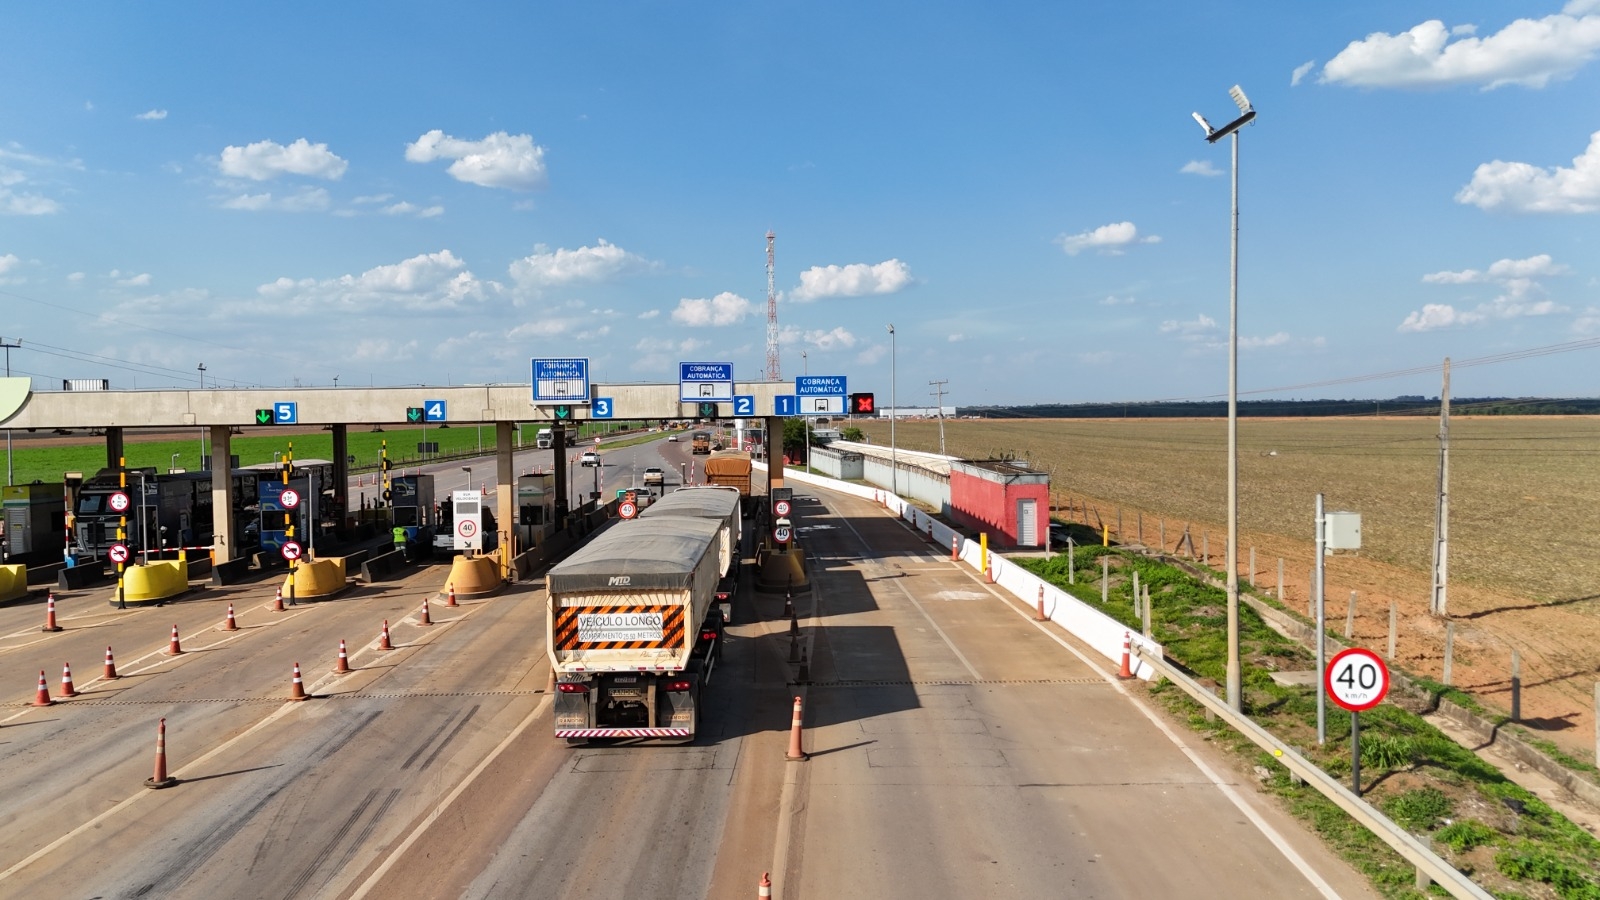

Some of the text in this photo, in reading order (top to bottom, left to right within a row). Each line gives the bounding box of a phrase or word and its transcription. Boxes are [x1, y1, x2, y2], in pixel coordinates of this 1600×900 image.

[687, 371, 726, 379] AUTOMÁTICA
[802, 378, 840, 386] COBRANÇA
[800, 385, 843, 393] AUTOMÁTICA
[428, 403, 443, 418] 4
[596, 401, 609, 415] 3
[738, 398, 750, 413] 2
[782, 398, 788, 412] 1
[279, 405, 292, 420] 5
[777, 528, 788, 537] 40
[608, 576, 631, 586] MTD
[580, 614, 661, 627] VEÍCULO LONGO
[580, 631, 623, 640] COMPRIMENTO
[637, 631, 661, 639] METROS
[1336, 664, 1376, 689] 40
[609, 688, 640, 696] RANDON
